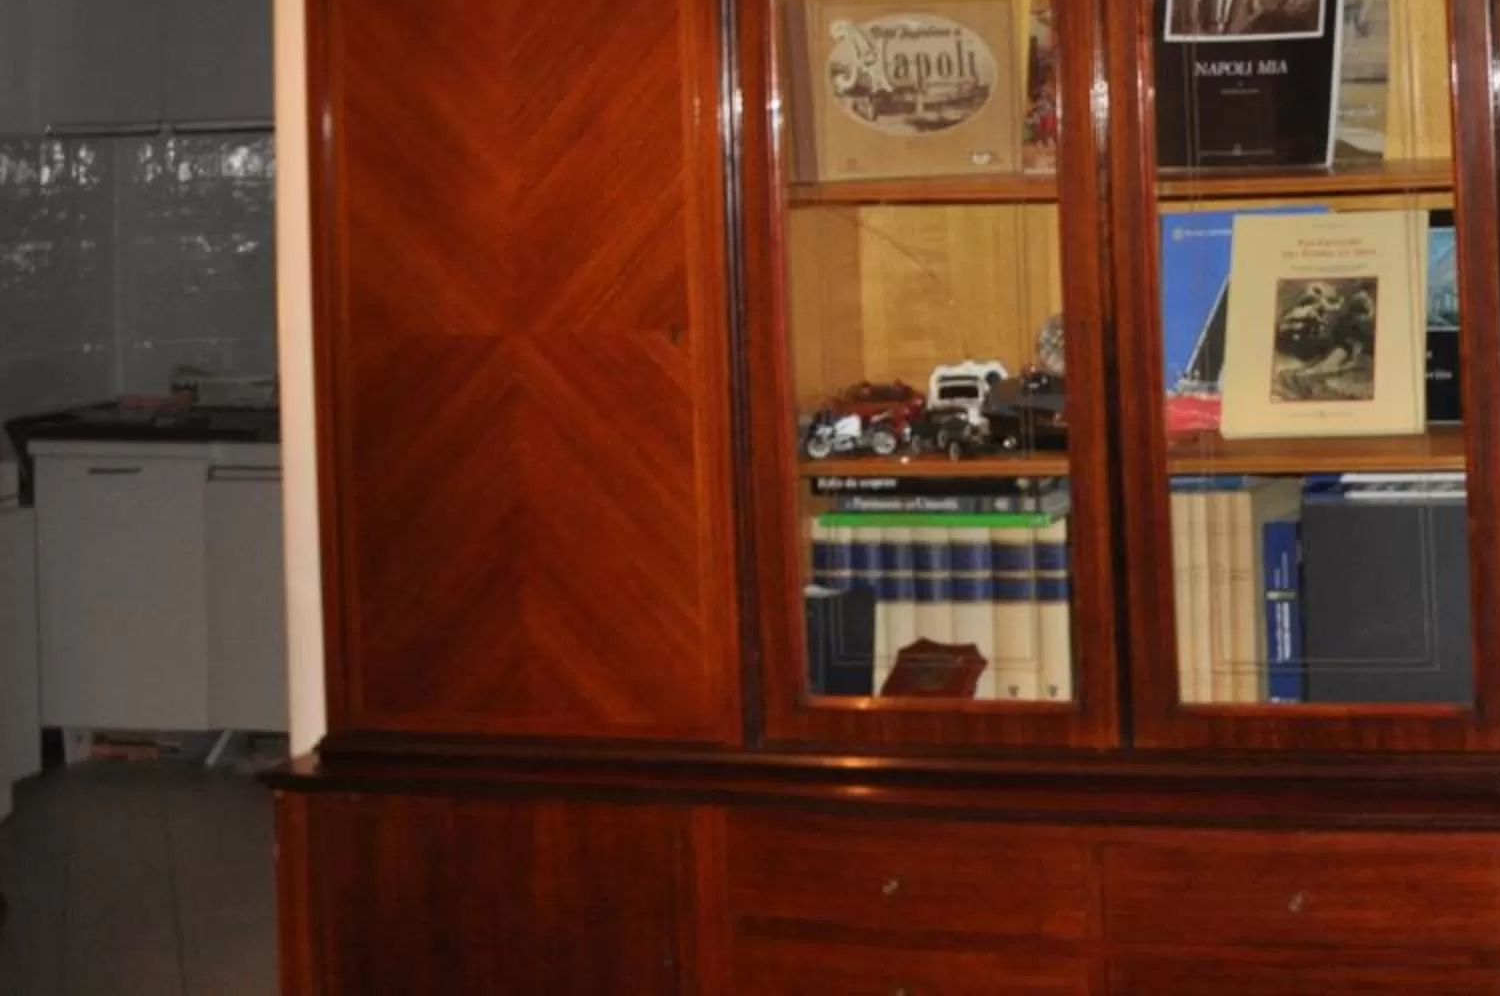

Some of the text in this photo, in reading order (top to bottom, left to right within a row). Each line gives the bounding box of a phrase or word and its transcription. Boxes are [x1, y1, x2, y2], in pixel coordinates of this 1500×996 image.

[830, 19, 980, 94] Napoli
[1194, 60, 1289, 77] NAPOLI MIA
